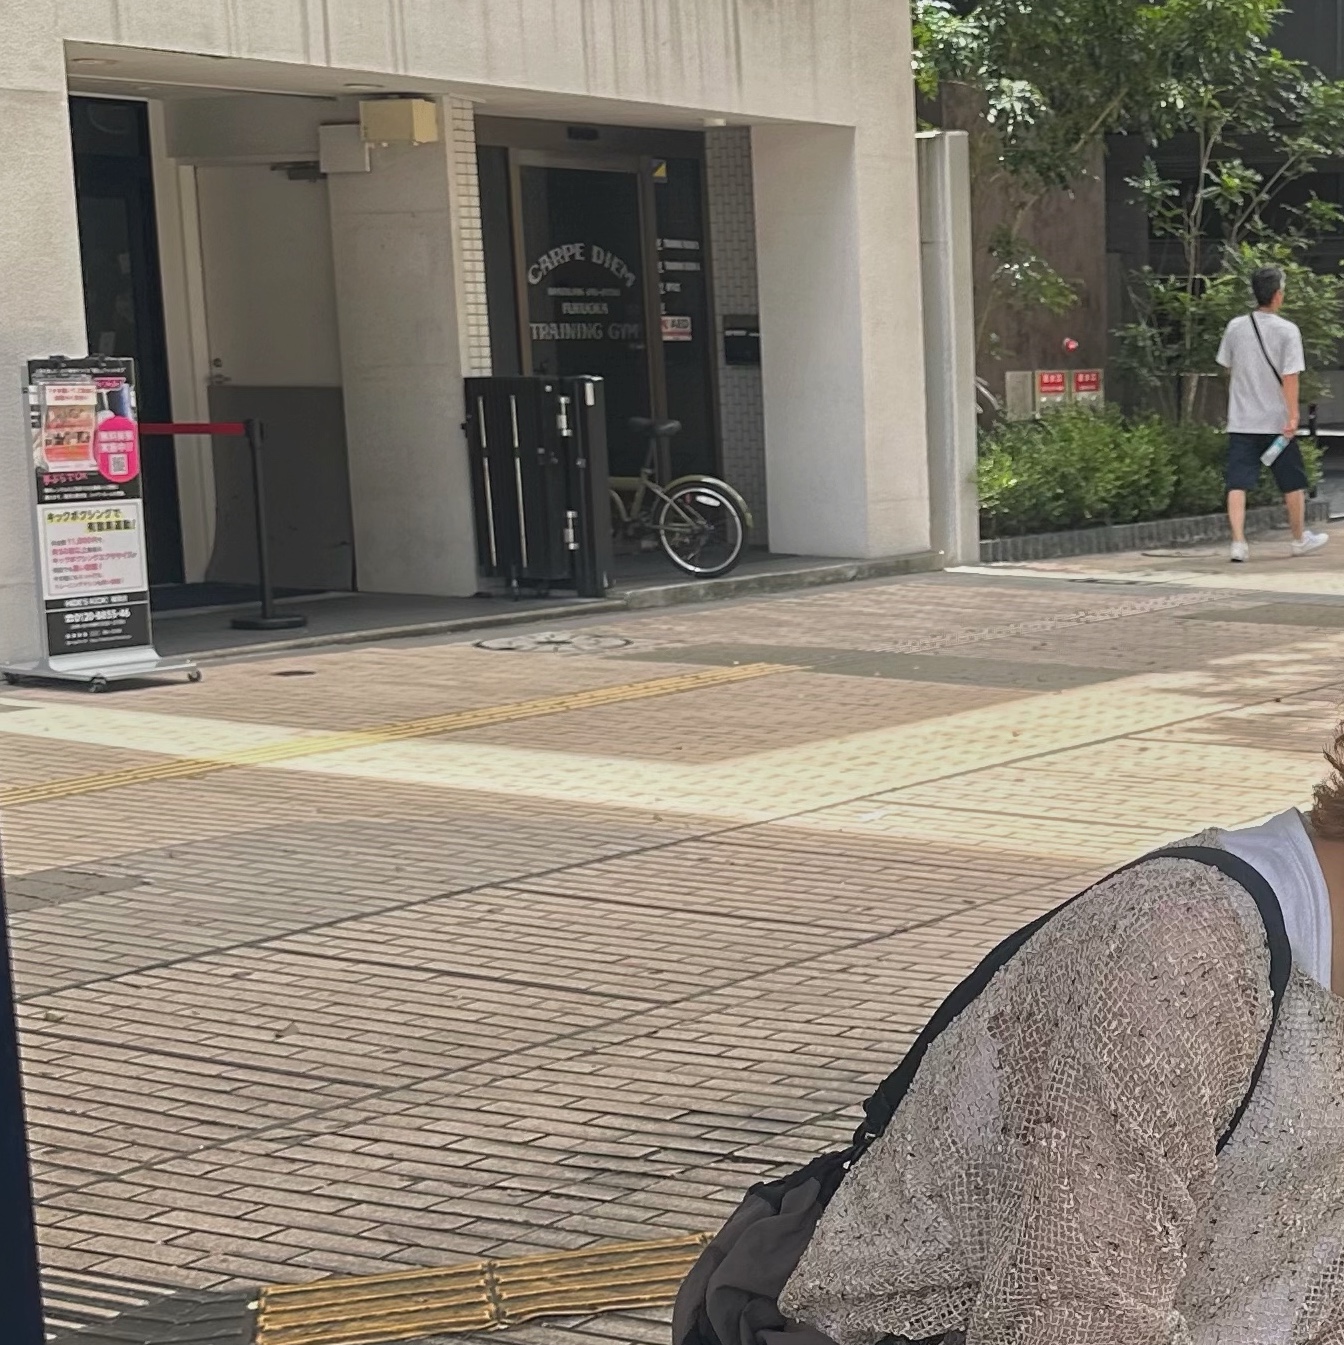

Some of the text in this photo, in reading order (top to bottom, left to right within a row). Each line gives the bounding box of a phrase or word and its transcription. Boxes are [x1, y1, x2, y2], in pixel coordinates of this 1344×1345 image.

[527, 242, 637, 288] CARPE DIEM
[529, 322, 603, 340] TRAINING
[607, 322, 640, 339] GYM
